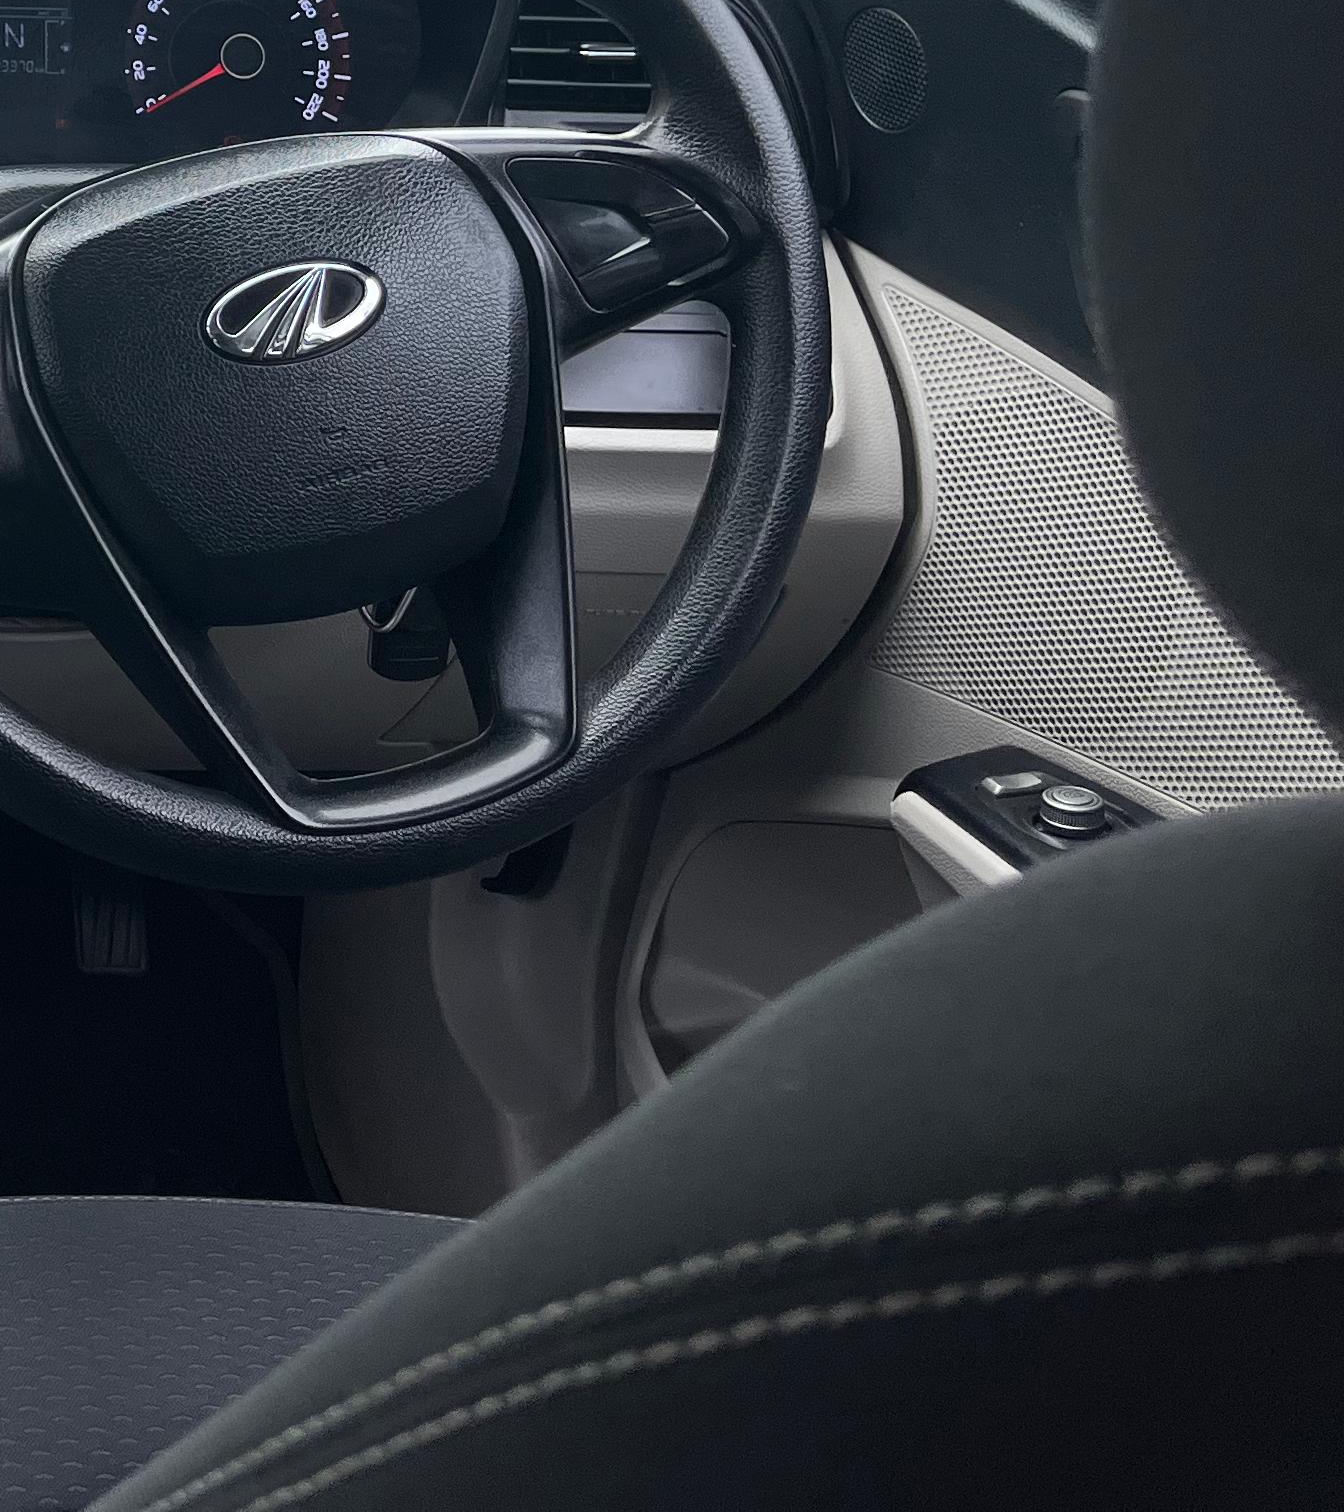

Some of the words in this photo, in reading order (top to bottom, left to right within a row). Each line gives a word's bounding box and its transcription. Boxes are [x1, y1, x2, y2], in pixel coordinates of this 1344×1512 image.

[4, 22, 25, 48] N
[134, 24, 148, 45] 40
[314, 28, 329, 51] 180
[132, 59, 145, 81] 20
[315, 59, 331, 89] 200
[302, 92, 324, 121] 220
